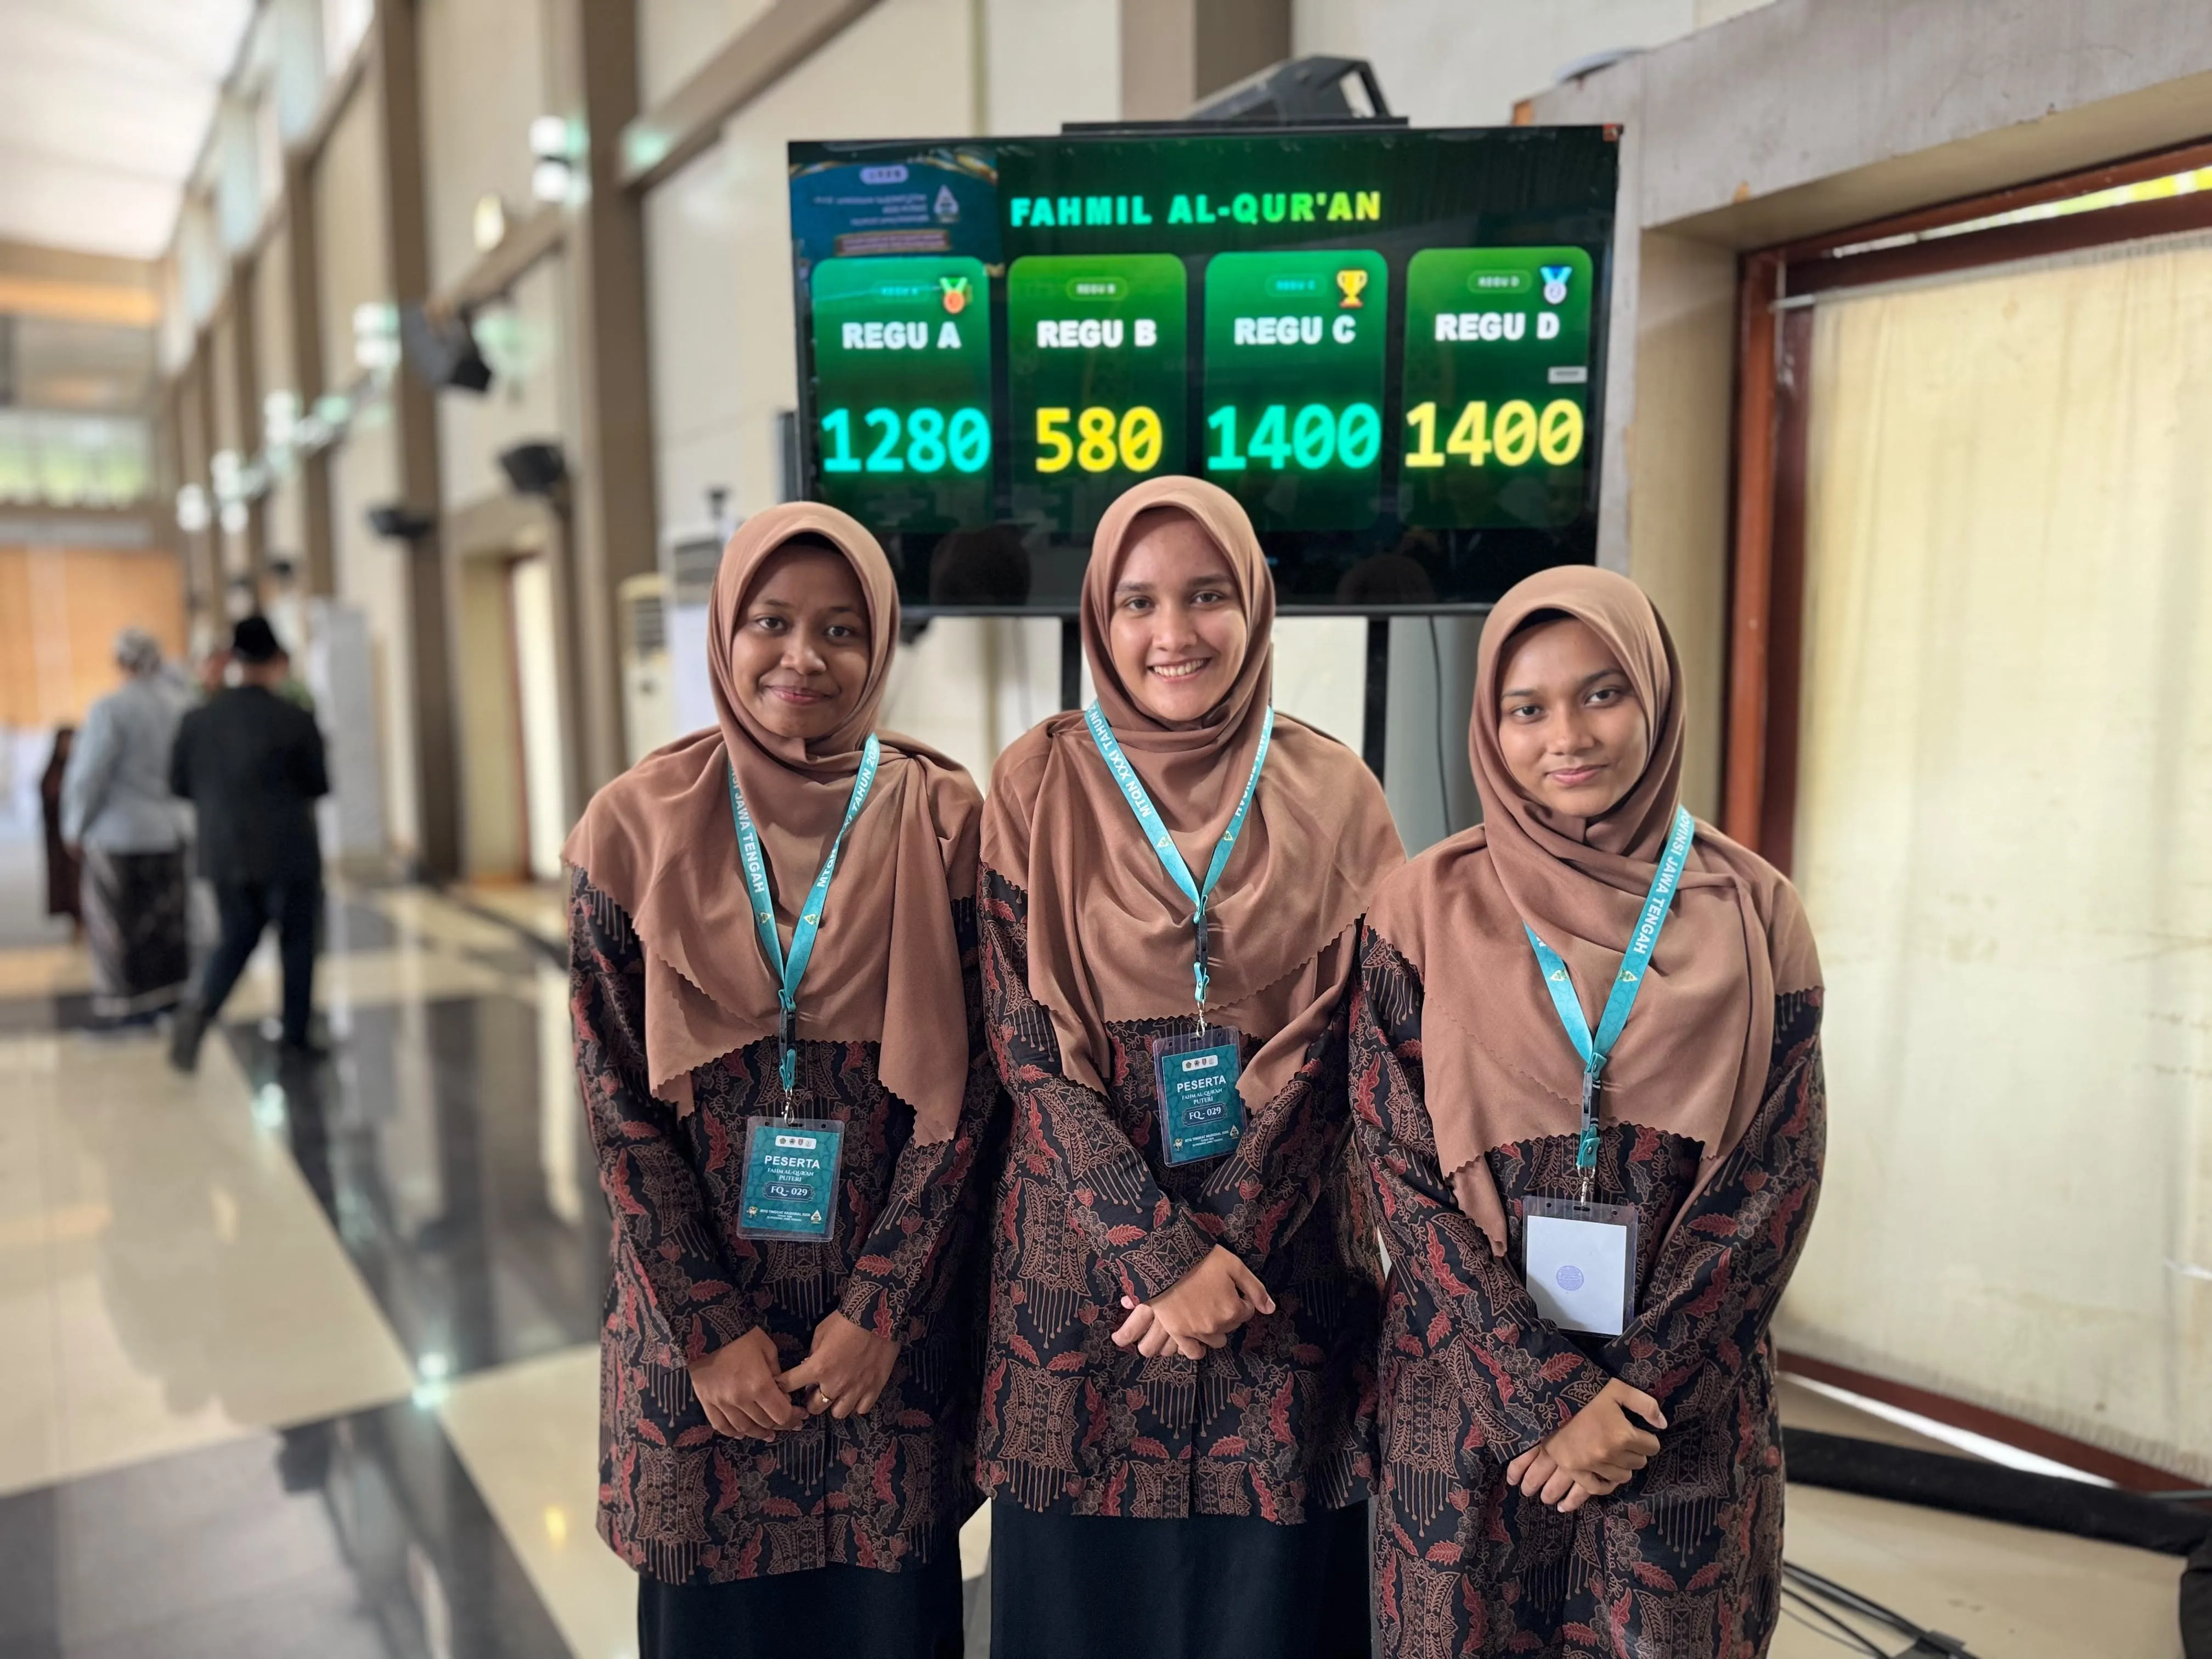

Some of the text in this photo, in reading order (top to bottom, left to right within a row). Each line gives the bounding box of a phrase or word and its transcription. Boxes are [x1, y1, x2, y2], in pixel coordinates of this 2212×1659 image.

[1011, 191, 1381, 226] FAHMIL AL-QUR'AN
[842, 322, 961, 349] REGU A
[1037, 320, 1158, 347] REGU B
[1234, 315, 1356, 345] REGU C
[1435, 313, 1560, 341] REGU D
[821, 408, 991, 472] 1280
[1036, 406, 1162, 472] 580
[1207, 403, 1381, 471] 1400
[1405, 399, 1584, 467] 1400
[1090, 711, 1152, 817] MTQN XXXI TAHUN
[852, 768, 872, 811] TAHUN
[735, 793, 765, 893] JAWA TENGAH
[1656, 856, 1678, 893] JAWA
[1633, 898, 1665, 954] TENGAH
[1177, 1075, 1226, 1093] PESERTA
[1207, 1107, 1221, 1116] 029
[764, 1155, 820, 1169] PESERTA
[791, 1187, 808, 1196] 029
